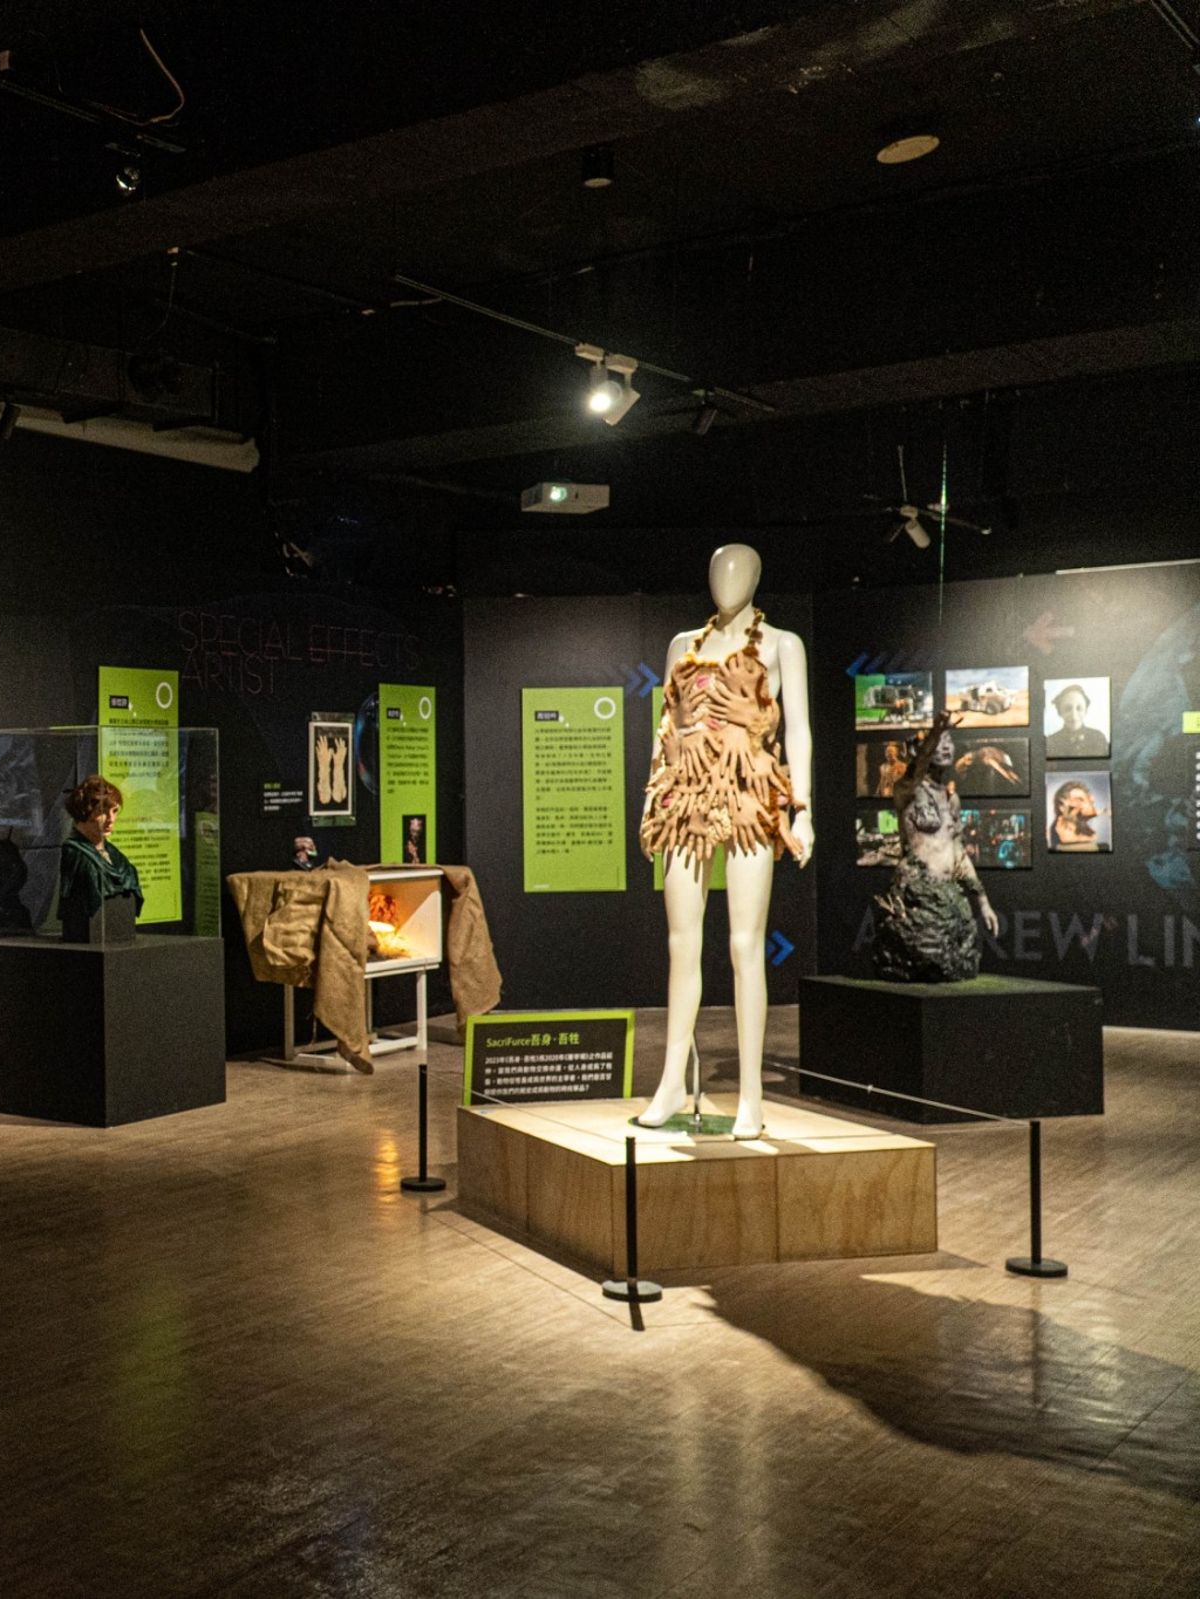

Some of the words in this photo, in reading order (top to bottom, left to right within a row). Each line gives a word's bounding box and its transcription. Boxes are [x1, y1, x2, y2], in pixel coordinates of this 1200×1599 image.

[179, 611, 303, 661] SPECIAL
[309, 624, 422, 670] EFFECTS
[181, 652, 279, 694] ARTIST
[851, 904, 1104, 962] AREW
